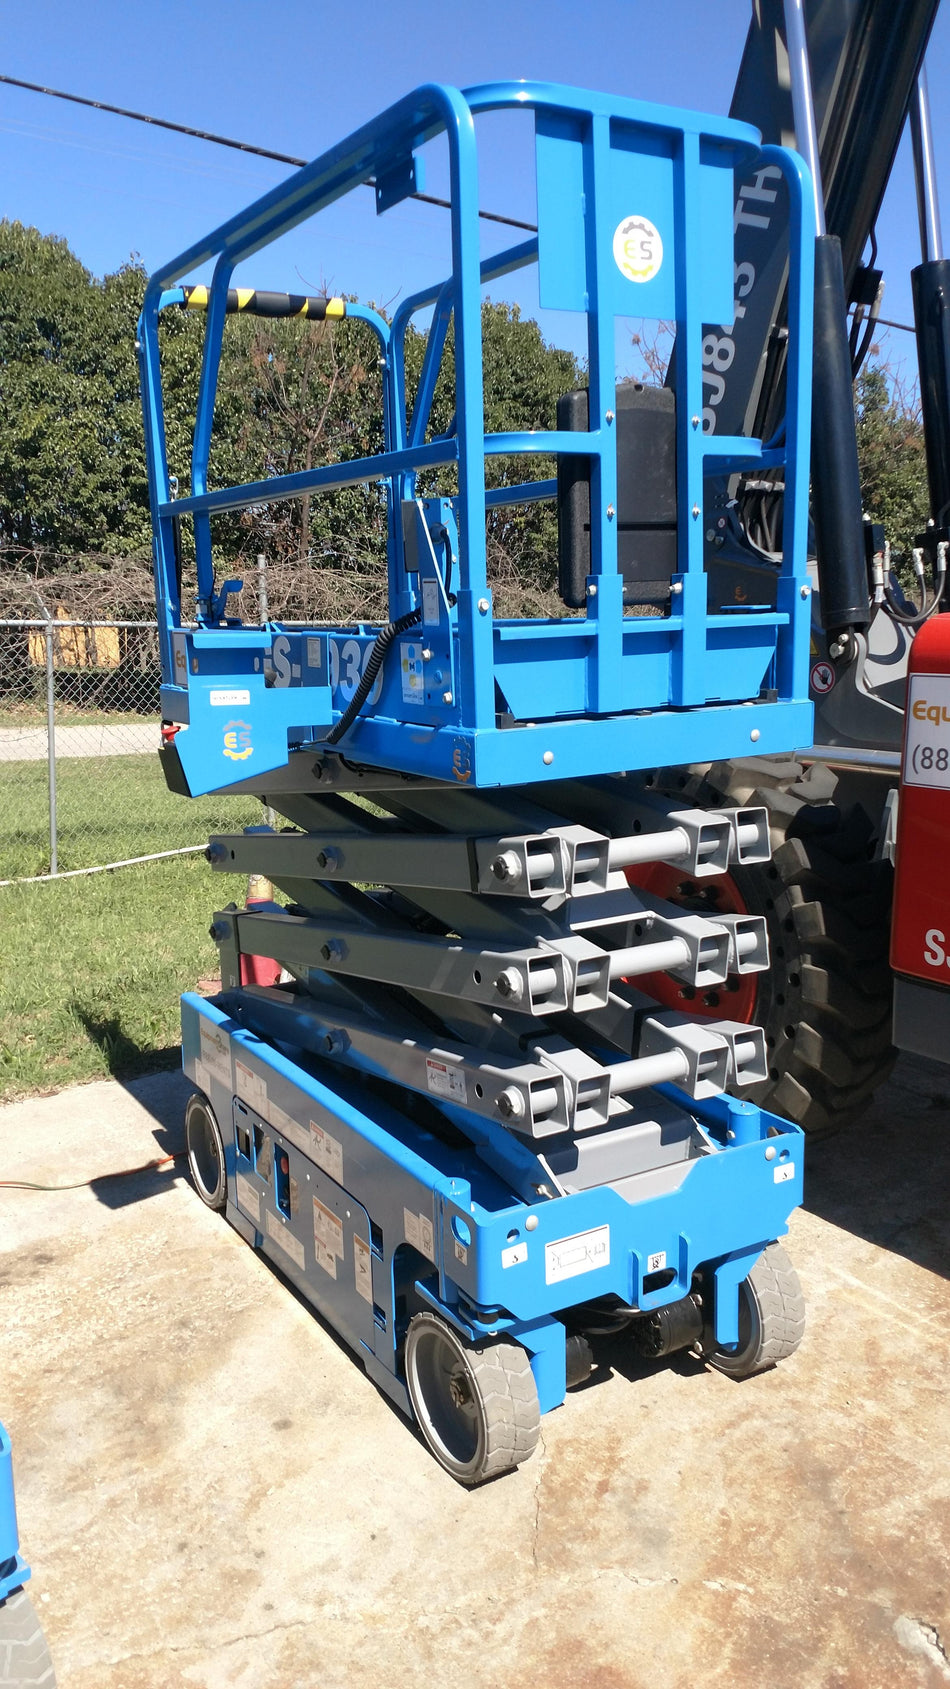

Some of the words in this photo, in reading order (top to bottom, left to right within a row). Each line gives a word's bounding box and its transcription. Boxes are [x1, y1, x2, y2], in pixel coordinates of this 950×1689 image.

[733, 165, 783, 234] TH
[623, 239, 653, 261] ES
[223, 731, 252, 749] ES
[924, 928, 950, 966] S
